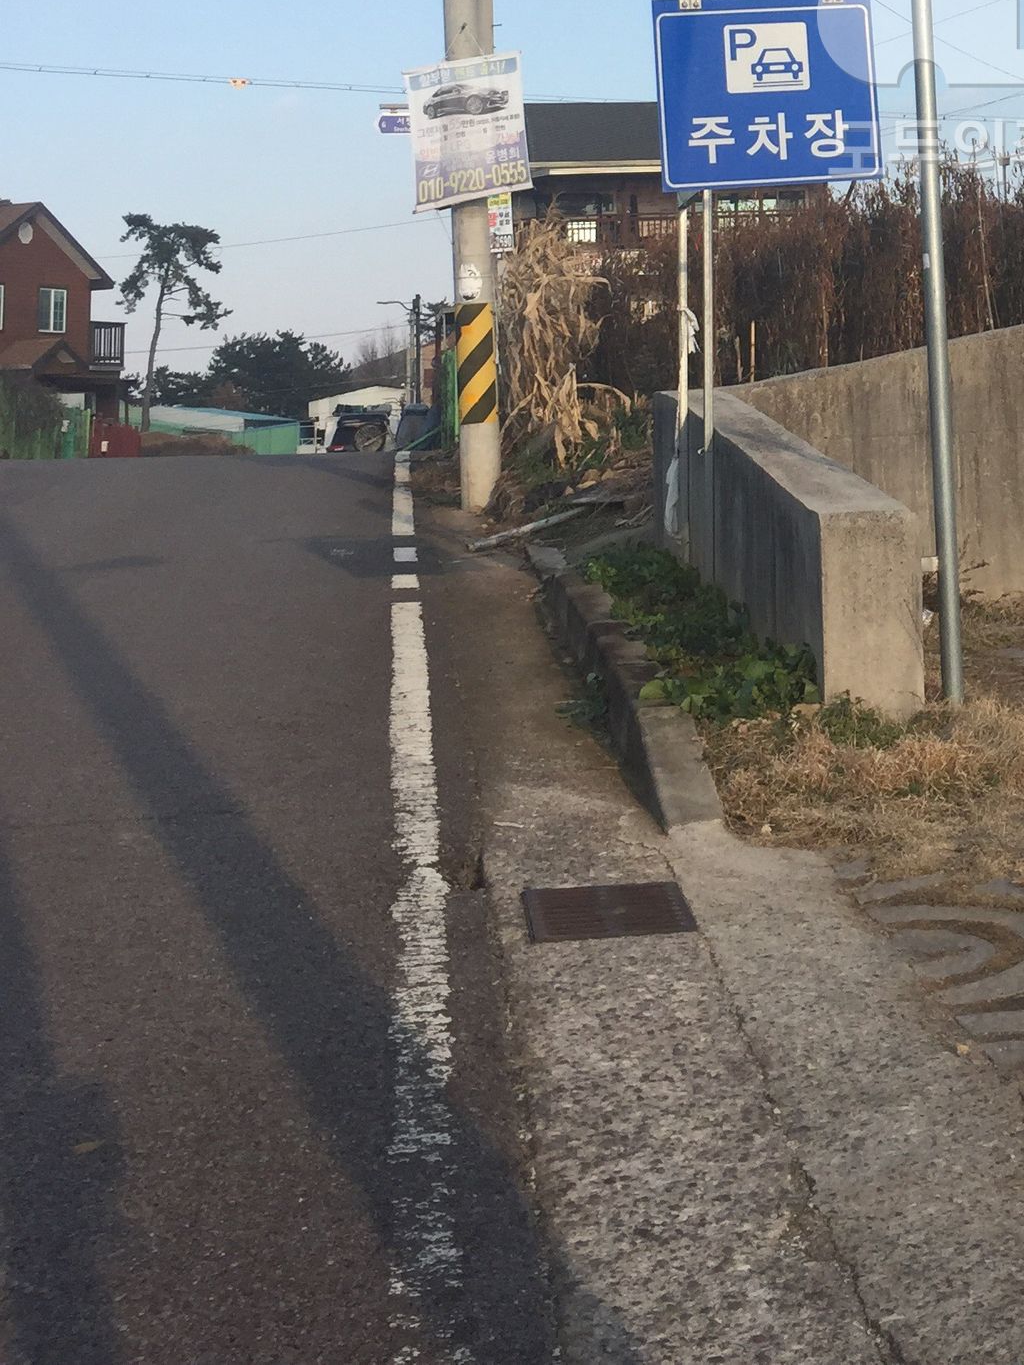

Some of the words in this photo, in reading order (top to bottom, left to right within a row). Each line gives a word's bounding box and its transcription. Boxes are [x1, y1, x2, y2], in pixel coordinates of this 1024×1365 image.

[729, 28, 757, 61] P
[688, 109, 849, 164] 주차장
[419, 160, 527, 203] 010-9220-0555
